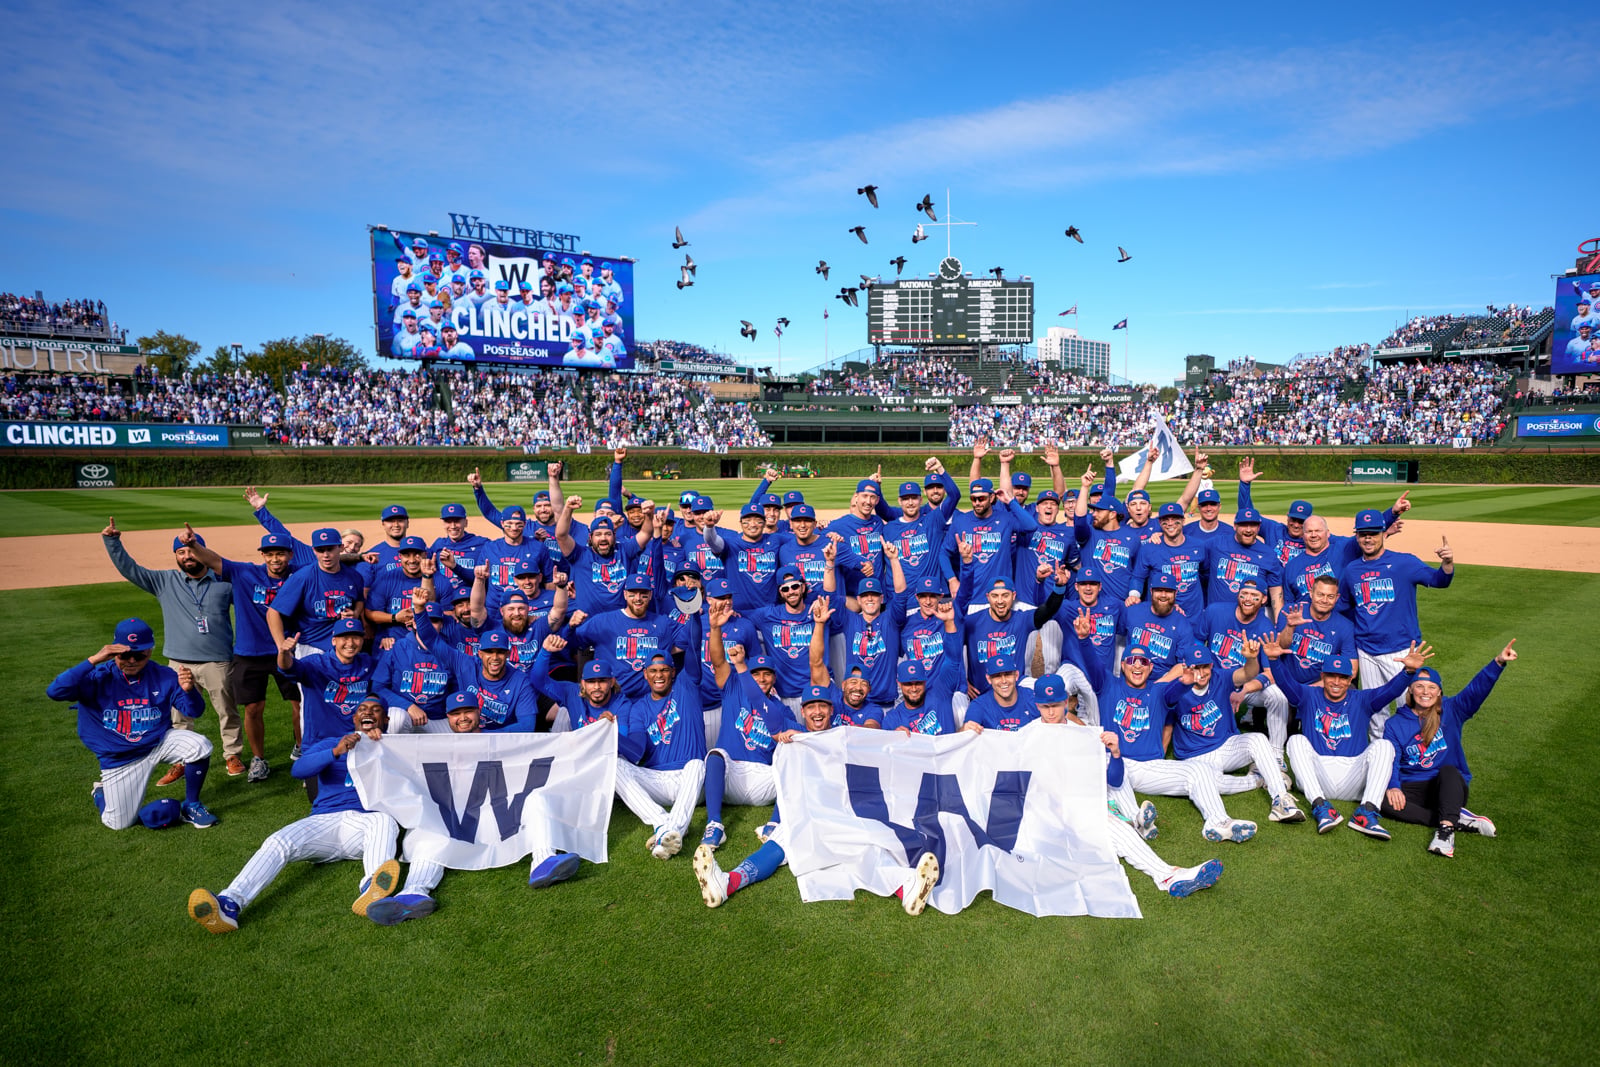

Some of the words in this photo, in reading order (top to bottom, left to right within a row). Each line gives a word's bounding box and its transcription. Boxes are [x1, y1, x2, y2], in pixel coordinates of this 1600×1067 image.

[448, 213, 580, 252] WINTRUST
[499, 264, 530, 290] W
[451, 306, 575, 343] CLINCHED
[0, 338, 121, 353] GLEYROOFTOPS.COM
[483, 344, 549, 358] POSTSEASON
[880, 396, 905, 404] YETI
[1098, 394, 1132, 402] Advocate
[1526, 422, 1583, 430] POSTSEASON
[6, 424, 117, 445] CLINCHED
[132, 430, 146, 441] W
[161, 432, 220, 442] POSTSEASON
[1457, 438, 1469, 447] W
[526, 444, 537, 454] W
[510, 468, 541, 476] Gallagher
[1353, 467, 1392, 475] SLOAN
[422, 756, 555, 844] W
[845, 763, 1032, 887] W
